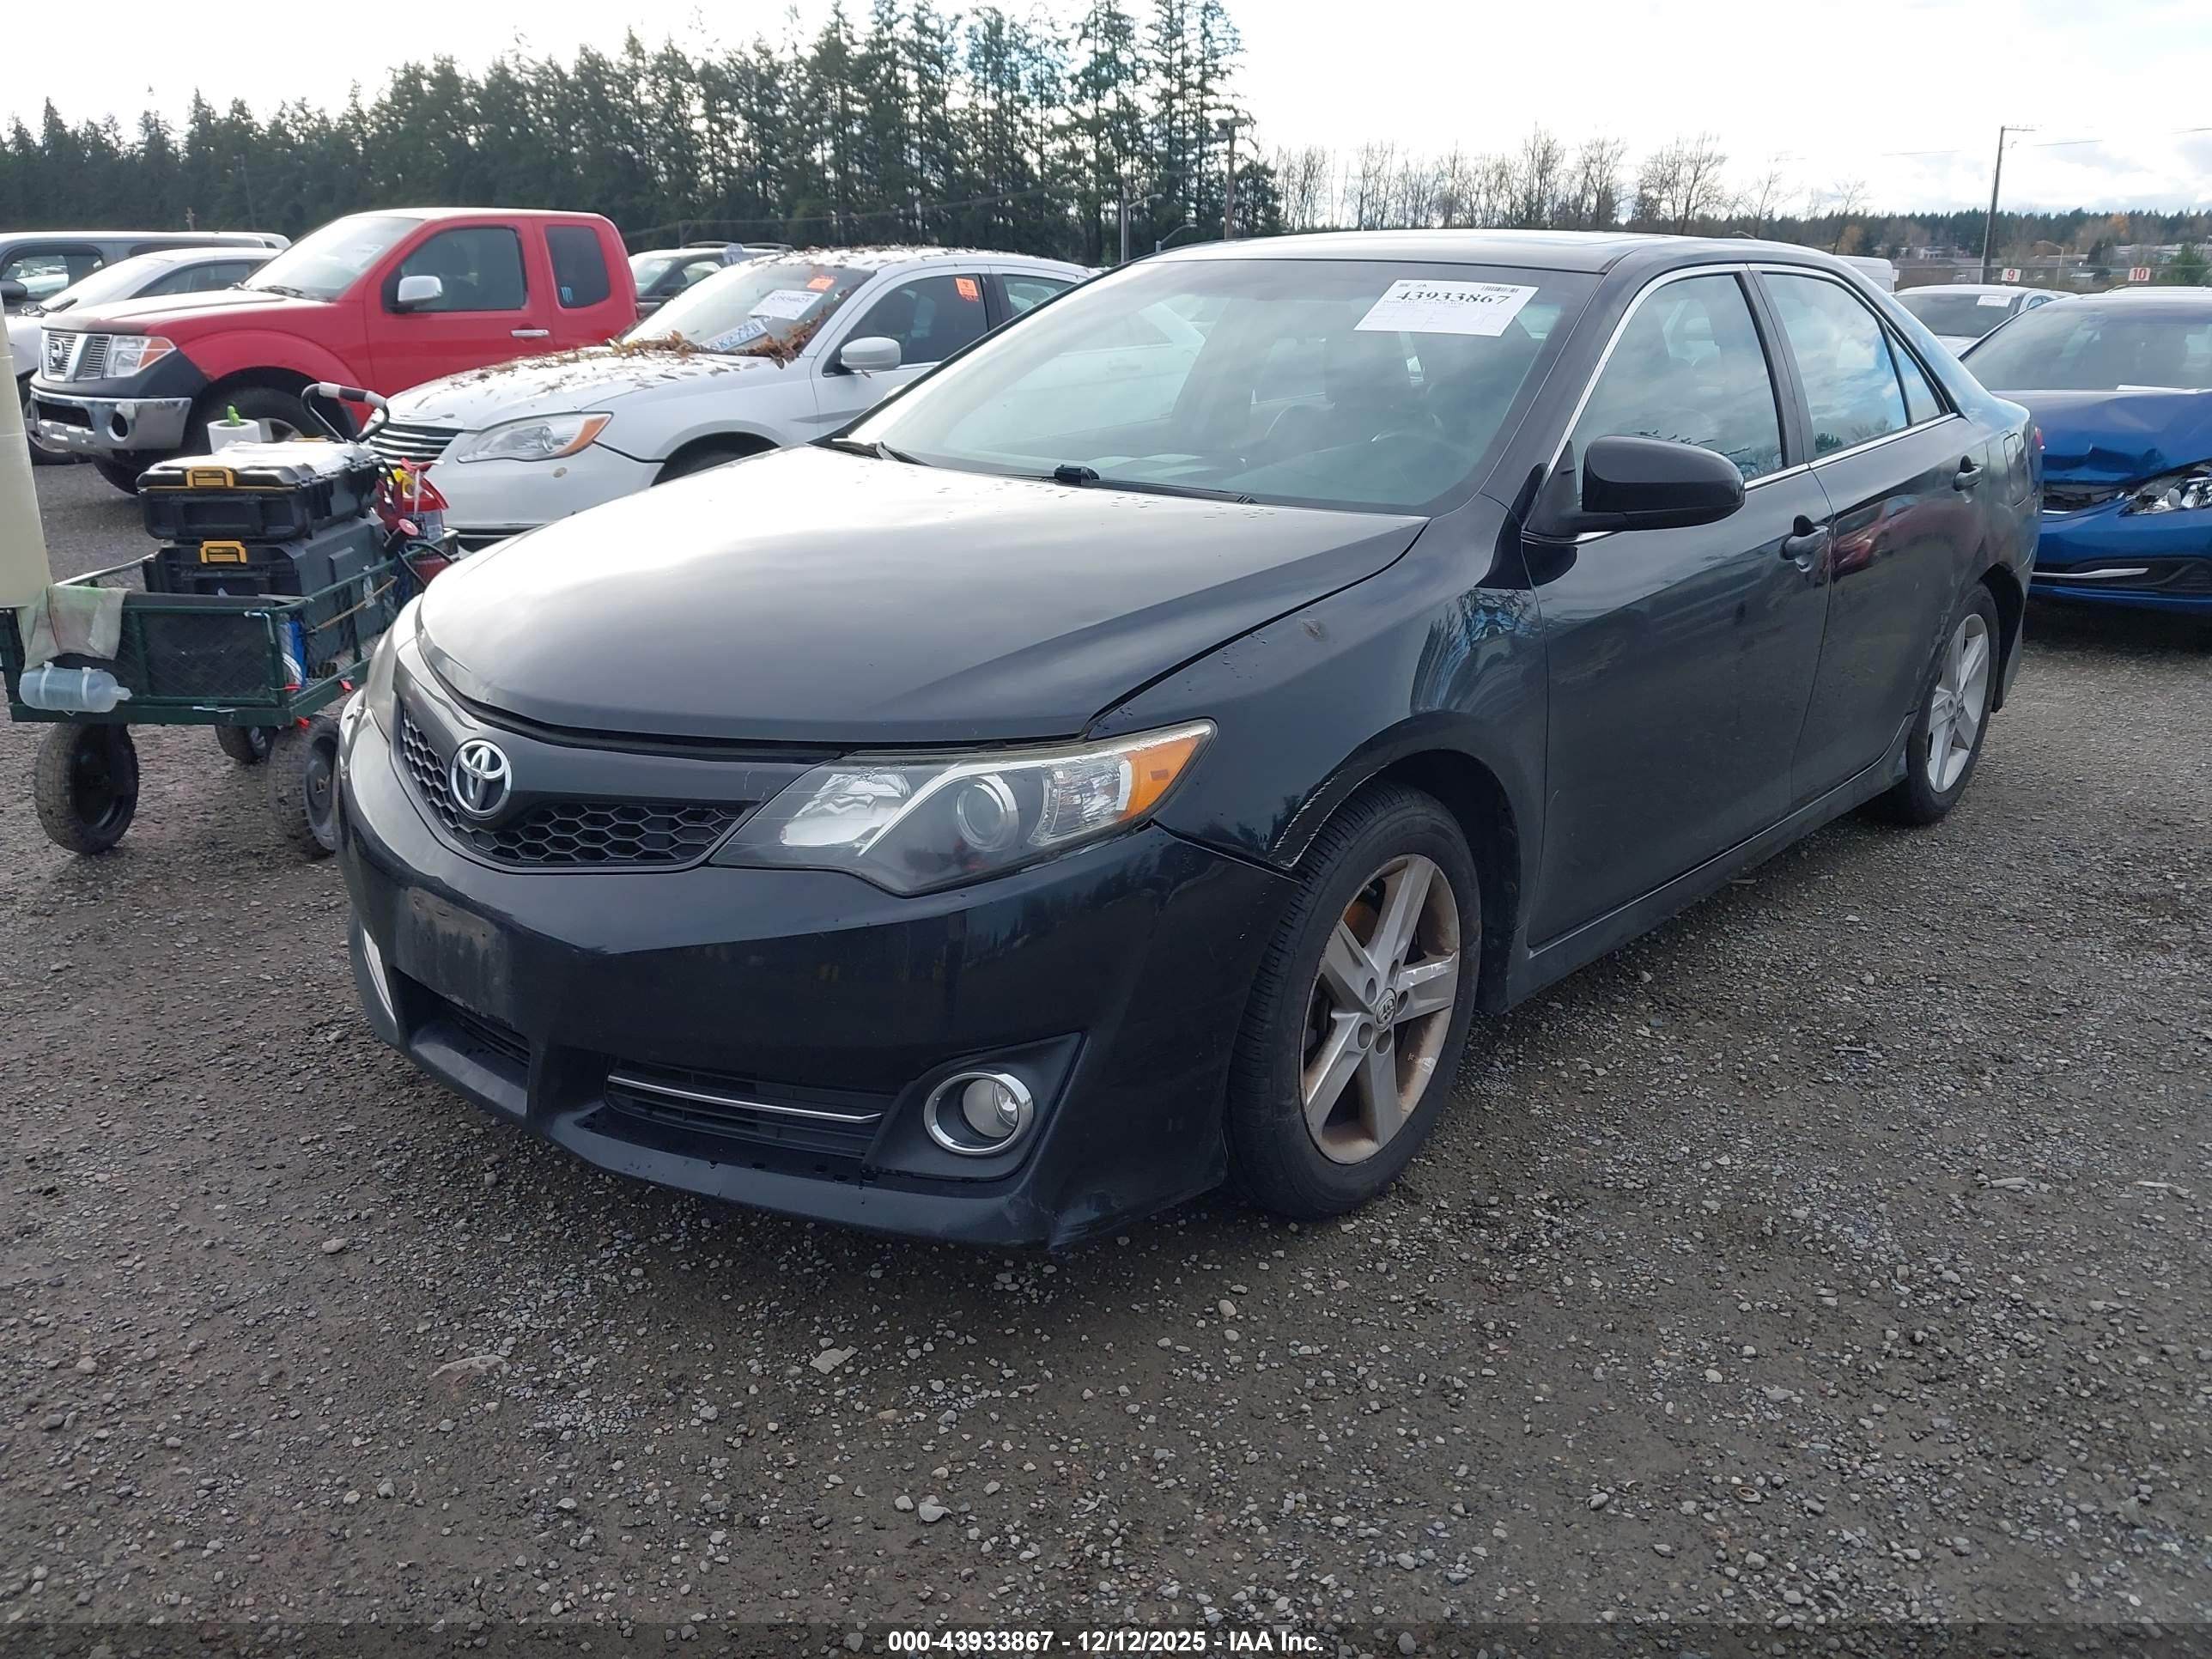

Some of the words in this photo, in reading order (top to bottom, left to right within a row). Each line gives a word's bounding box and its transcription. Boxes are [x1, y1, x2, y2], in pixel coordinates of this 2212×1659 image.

[2007, 269, 2015, 281] 9
[2133, 268, 2147, 280] 10
[1395, 290, 1511, 304] 43933867
